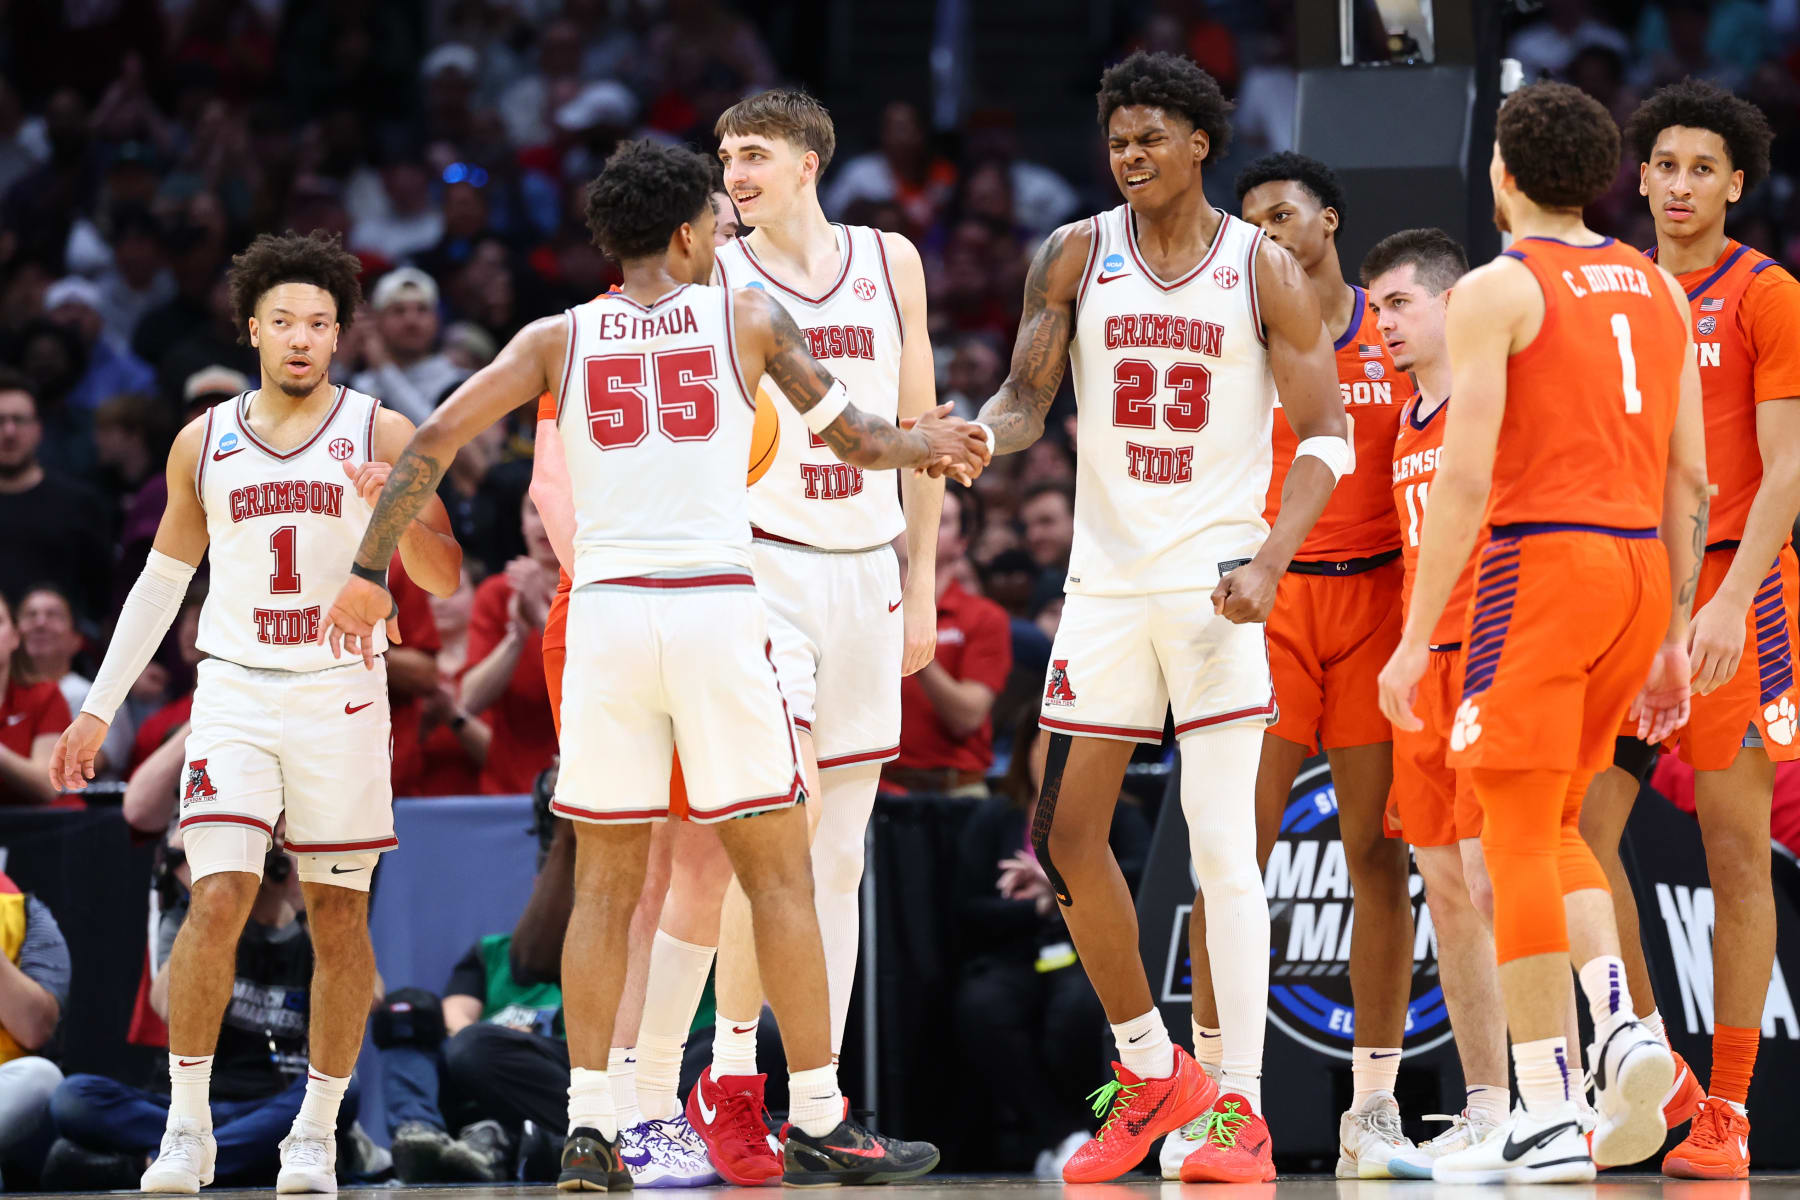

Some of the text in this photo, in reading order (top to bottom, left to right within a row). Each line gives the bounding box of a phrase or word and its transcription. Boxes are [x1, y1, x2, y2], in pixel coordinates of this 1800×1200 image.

[853, 279, 876, 299] SEC
[1213, 267, 1239, 288] SEC
[1562, 264, 1653, 298] C. HUNTER
[600, 305, 698, 340] ESTRADA
[1105, 314, 1225, 357] CRIMSON
[800, 325, 875, 360] MSON
[1610, 313, 1642, 414] 1
[583, 345, 719, 451] 55
[1113, 358, 1212, 432] 23
[329, 440, 354, 459] SEC
[1126, 441, 1194, 484] TIDE
[800, 463, 864, 499] TIDE
[229, 481, 344, 522] CRIMSON
[270, 526, 301, 594] 1
[253, 606, 321, 645] TIDE
